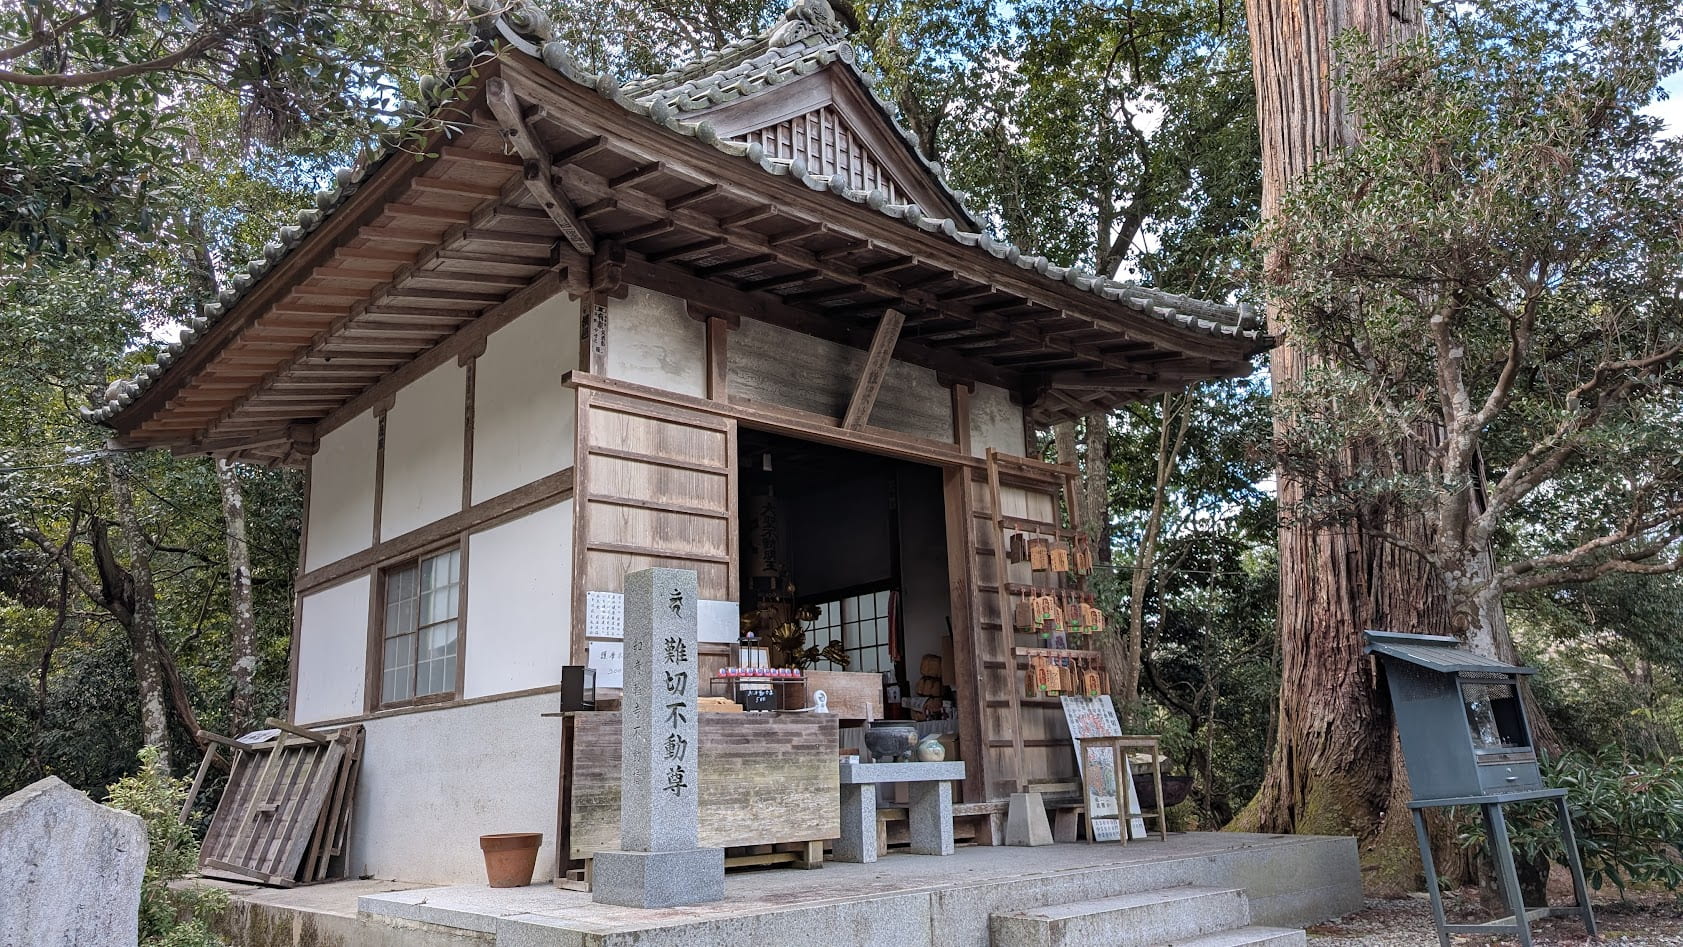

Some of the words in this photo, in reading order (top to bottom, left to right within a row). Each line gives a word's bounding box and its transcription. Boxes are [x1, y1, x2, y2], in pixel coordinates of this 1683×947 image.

[663, 636, 689, 798] 難切不動尊
